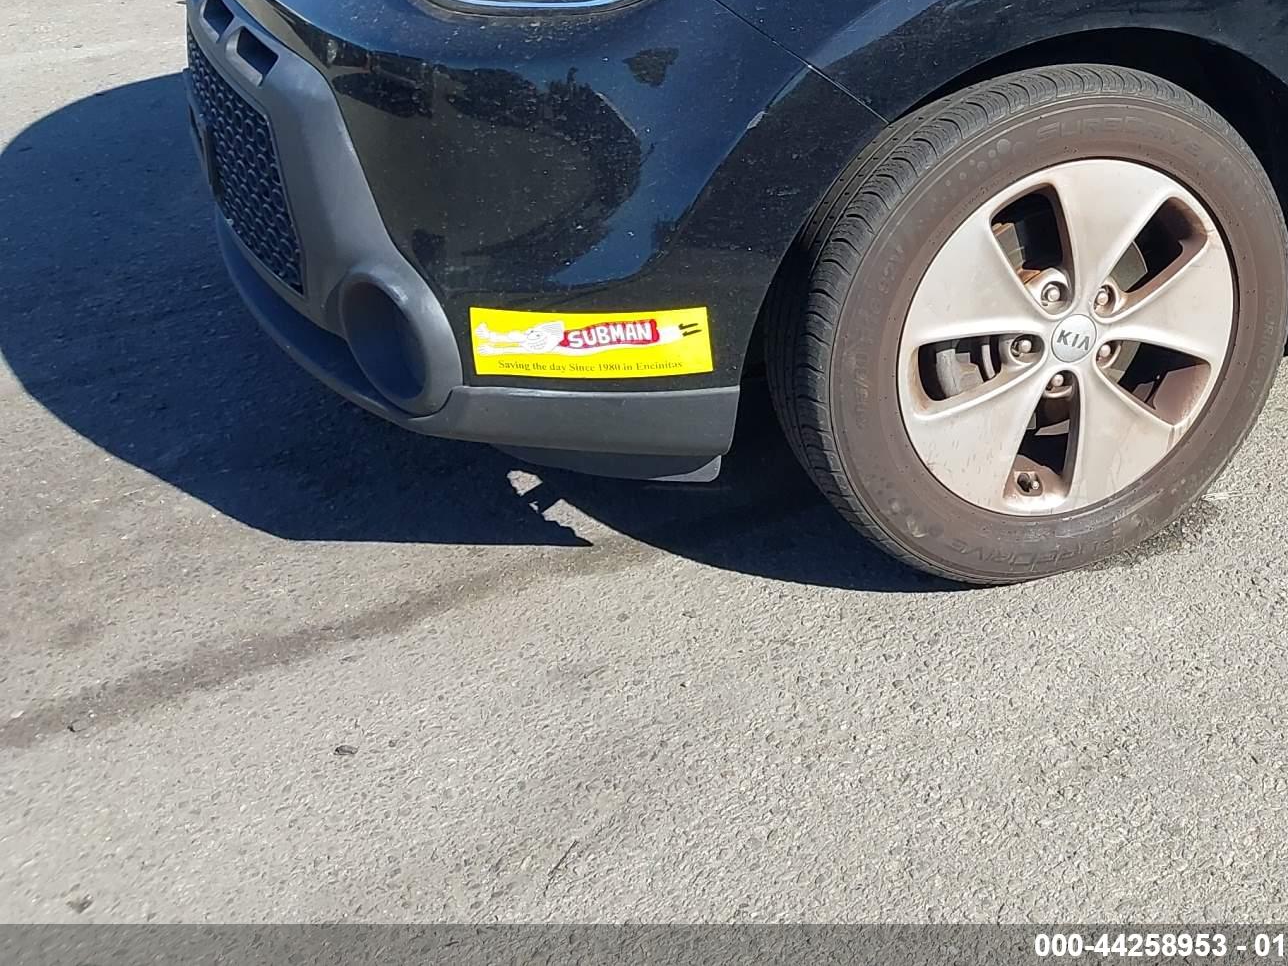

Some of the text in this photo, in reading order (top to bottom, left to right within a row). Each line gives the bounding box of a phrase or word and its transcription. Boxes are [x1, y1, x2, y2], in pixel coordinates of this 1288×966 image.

[568, 321, 652, 349] SUBMAN
[1056, 329, 1091, 351] KIA
[498, 359, 683, 373] Saving the day Since 1980 in Encinitas
